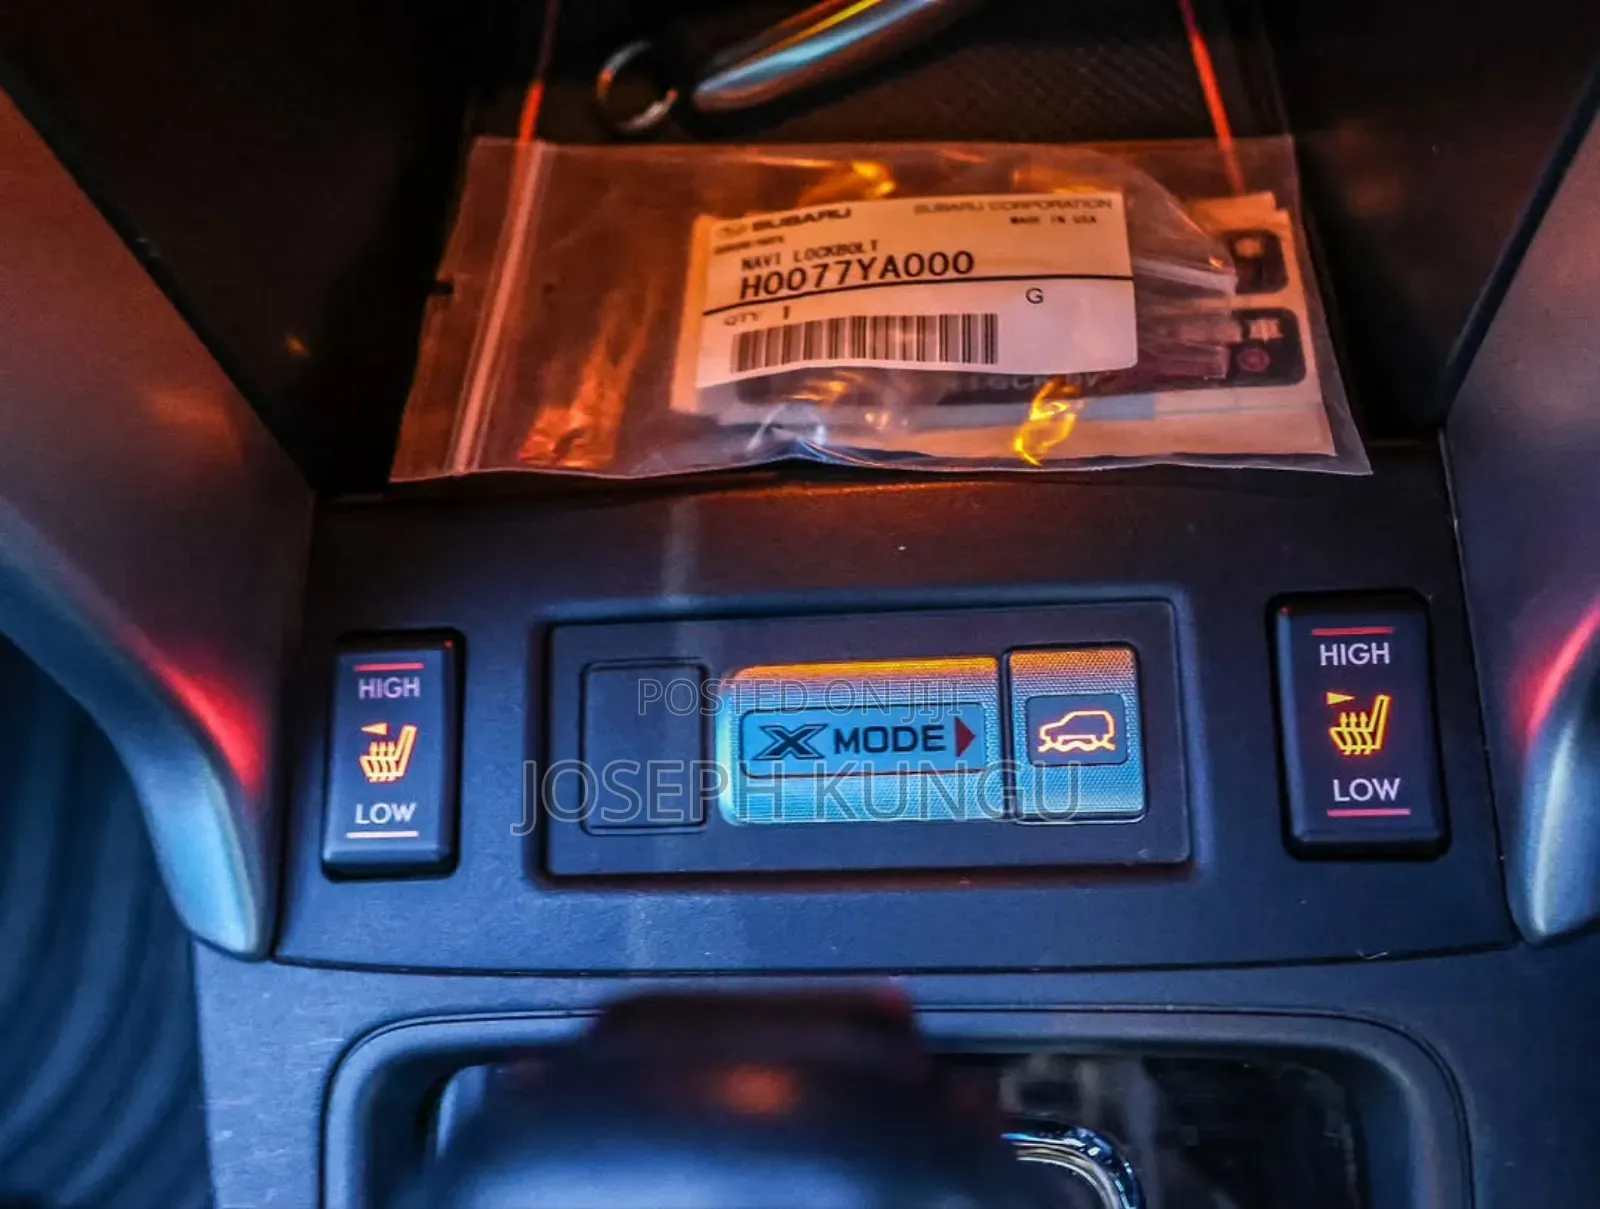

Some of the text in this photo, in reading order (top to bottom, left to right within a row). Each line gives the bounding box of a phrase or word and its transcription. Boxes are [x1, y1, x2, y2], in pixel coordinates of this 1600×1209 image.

[914, 198, 1112, 215] SUBARU CORPORATION
[752, 207, 851, 232] SUBARU
[741, 253, 781, 272] NAVI
[793, 239, 878, 263] LOCKBOLT
[739, 250, 974, 300] H0077YA000
[1025, 287, 1044, 304] G
[723, 312, 760, 326] QTY
[1319, 642, 1391, 666] HIGH
[358, 677, 421, 699] HIGH
[834, 725, 946, 754] MODE
[1333, 778, 1400, 802] LOW
[356, 803, 416, 824] LOW
